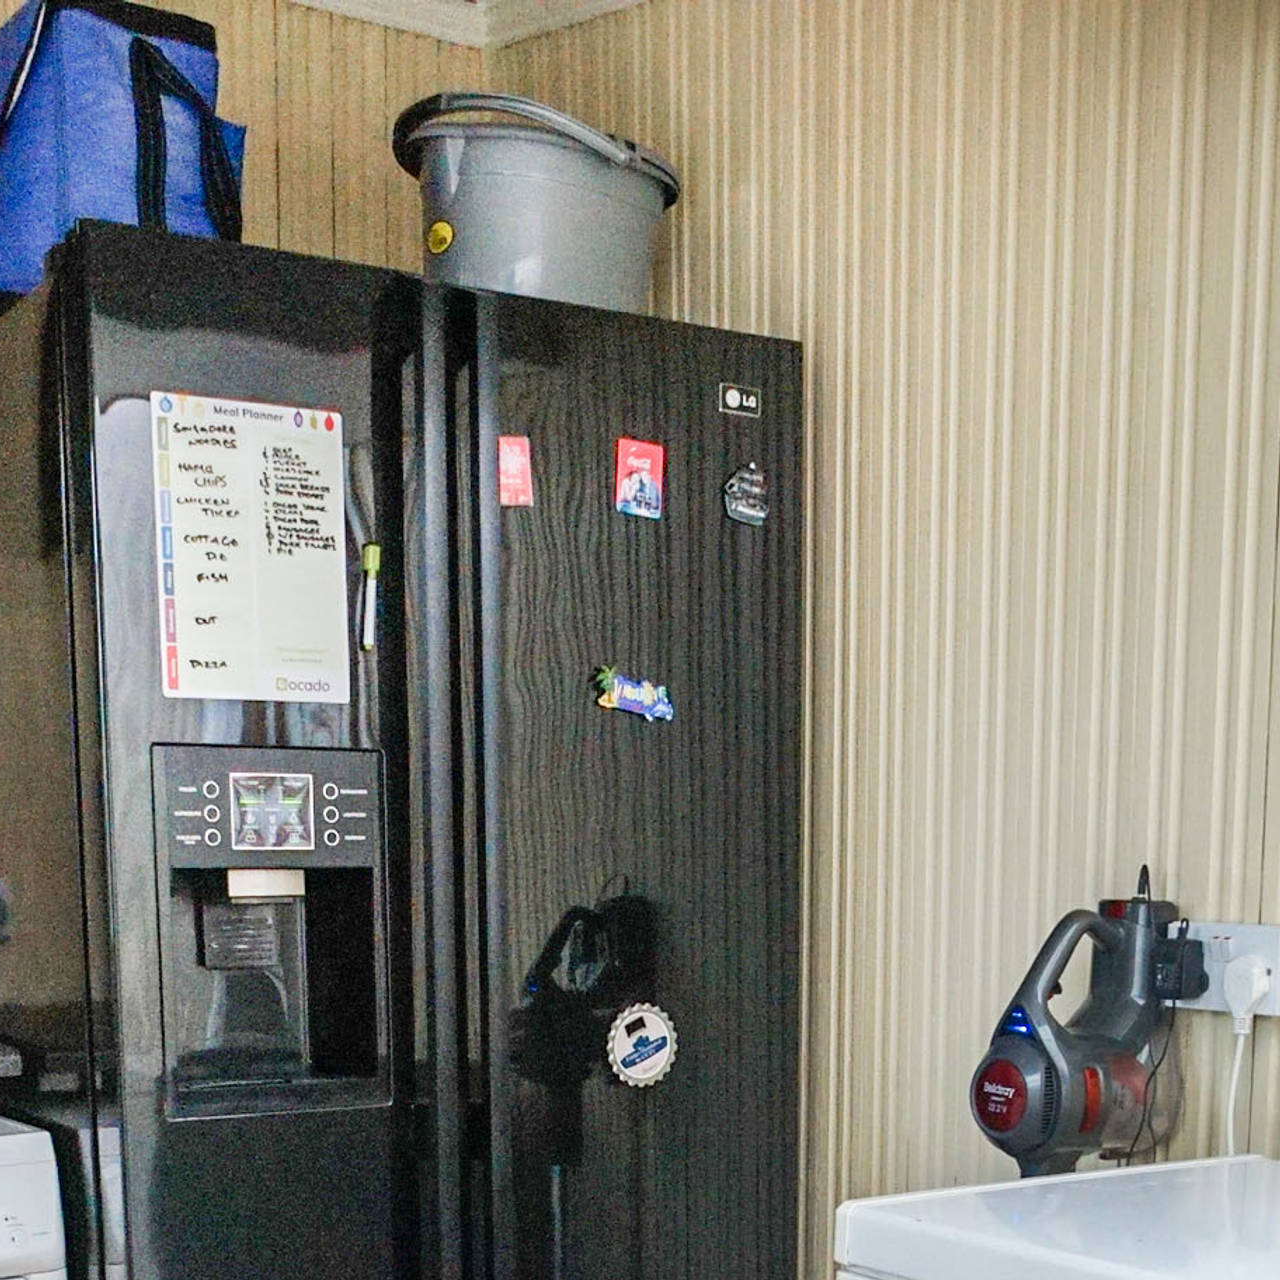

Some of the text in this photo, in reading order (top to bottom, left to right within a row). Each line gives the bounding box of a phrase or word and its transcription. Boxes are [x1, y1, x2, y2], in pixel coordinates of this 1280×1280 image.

[742, 394, 757, 408] LG
[213, 405, 284, 422] Meal Planner
[194, 475, 228, 488] CHIPS
[176, 496, 230, 506] CHICKEN
[196, 572, 229, 583] FISH
[195, 616, 219, 626] OUT
[288, 679, 330, 692] ocado
